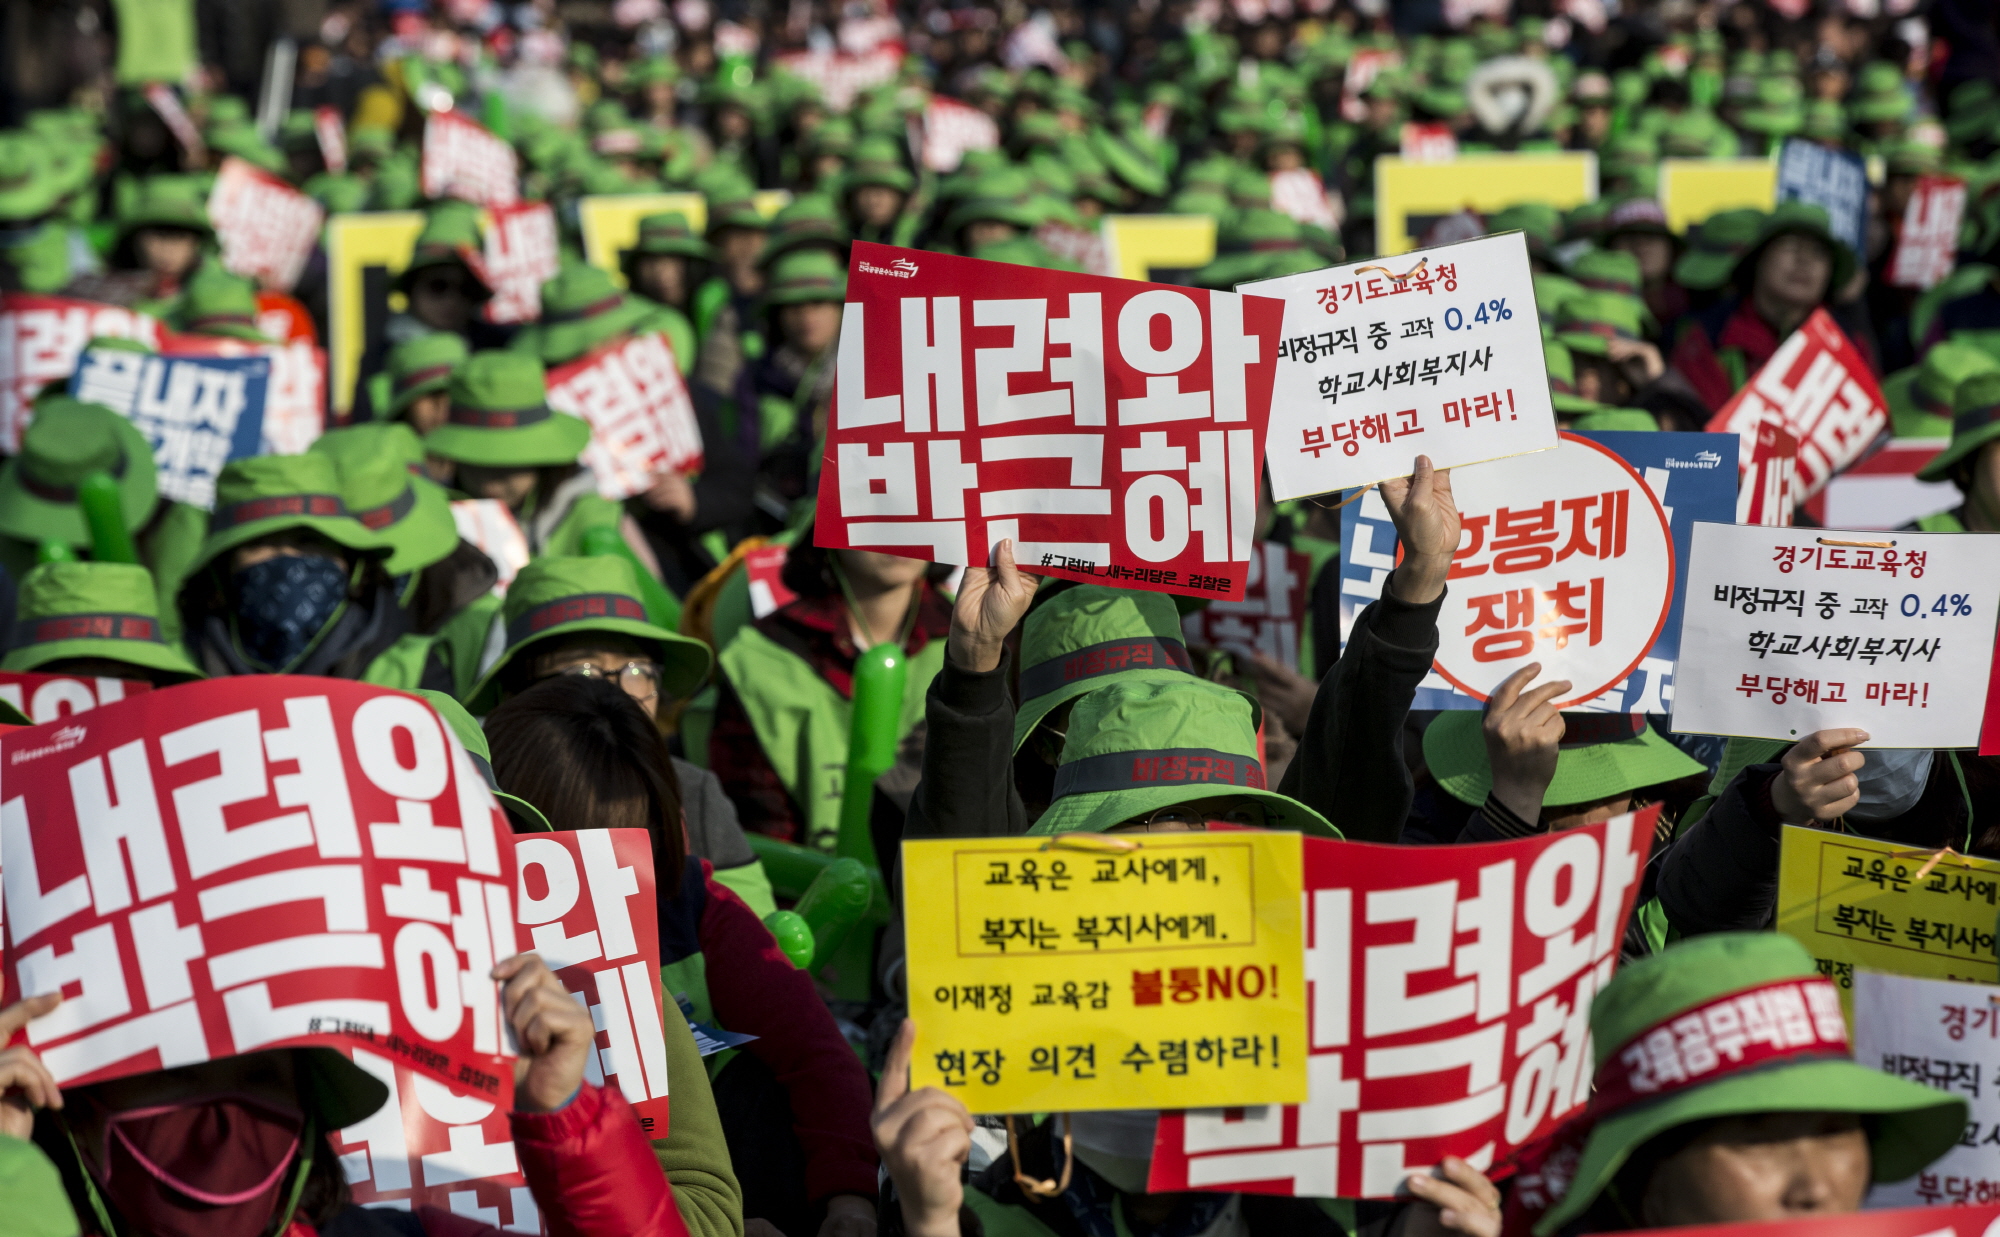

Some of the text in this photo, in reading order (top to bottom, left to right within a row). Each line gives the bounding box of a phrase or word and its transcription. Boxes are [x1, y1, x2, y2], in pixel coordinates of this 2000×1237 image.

[1316, 262, 1458, 314] 경기도교육청
[1277, 297, 1513, 364] 비정규직 중 고작 0.4%
[837, 289, 1260, 433] 내려와
[1317, 346, 1493, 405] 학교사회복지사
[1299, 388, 1518, 459] 부당해고 마라!
[837, 429, 1257, 568] 박근혜
[1772, 545, 1927, 579] 경기도교육청
[1464, 576, 1605, 664] 쟁취
[1713, 584, 1972, 620] 비정규직 중 고작 0.4%
[1064, 643, 1154, 681] 비정규직
[1748, 630, 1941, 666] 학교사회복지사
[1736, 673, 1930, 709] 부당해고 마라!
[1131, 756, 1236, 785] 비정규직
[0, 695, 502, 949] 내려와
[984, 856, 1221, 893] 교육은 교사에게,
[1842, 855, 2000, 906] 교육은 교사에
[980, 912, 1229, 954] 복지는 복지사에게.
[1832, 903, 1897, 943] 복지는
[16, 864, 518, 1084] 박근혜
[934, 963, 1280, 1016] 이재정 교육감 불통NO!
[1940, 1003, 2000, 1042] 경기
[934, 1033, 1280, 1087] 현장 의견 수렴하라!
